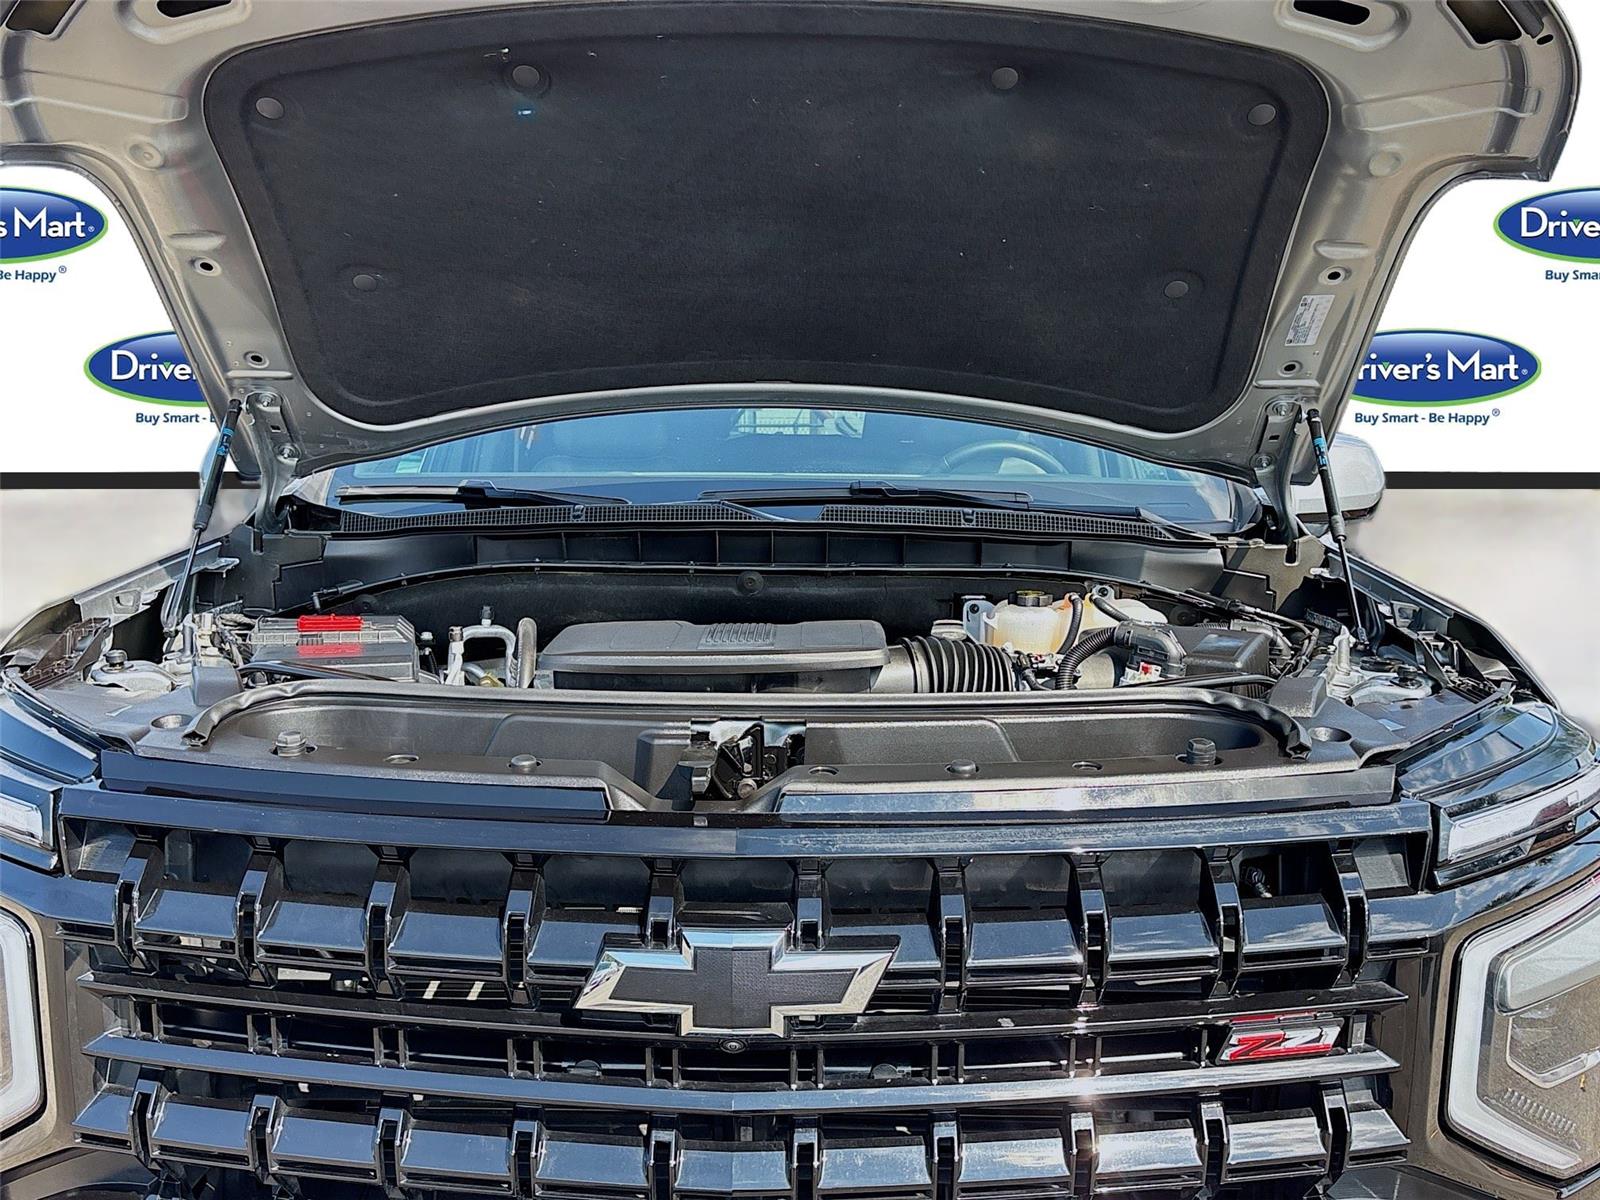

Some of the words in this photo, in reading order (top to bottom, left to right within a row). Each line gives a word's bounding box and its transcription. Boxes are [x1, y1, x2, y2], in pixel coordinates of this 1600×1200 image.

[14, 206, 86, 237] Mart
[15, 269, 57, 283] Happy
[1545, 270, 1570, 283] Buy
[112, 350, 197, 380] Drive
[1448, 349, 1519, 380] Mart
[136, 413, 160, 425] Buy
[163, 413, 200, 423] Smart
[1355, 412, 1379, 426] Buy
[1382, 412, 1419, 423] Smart
[1429, 412, 1445, 423] Be
[1448, 412, 1490, 426] Happy
